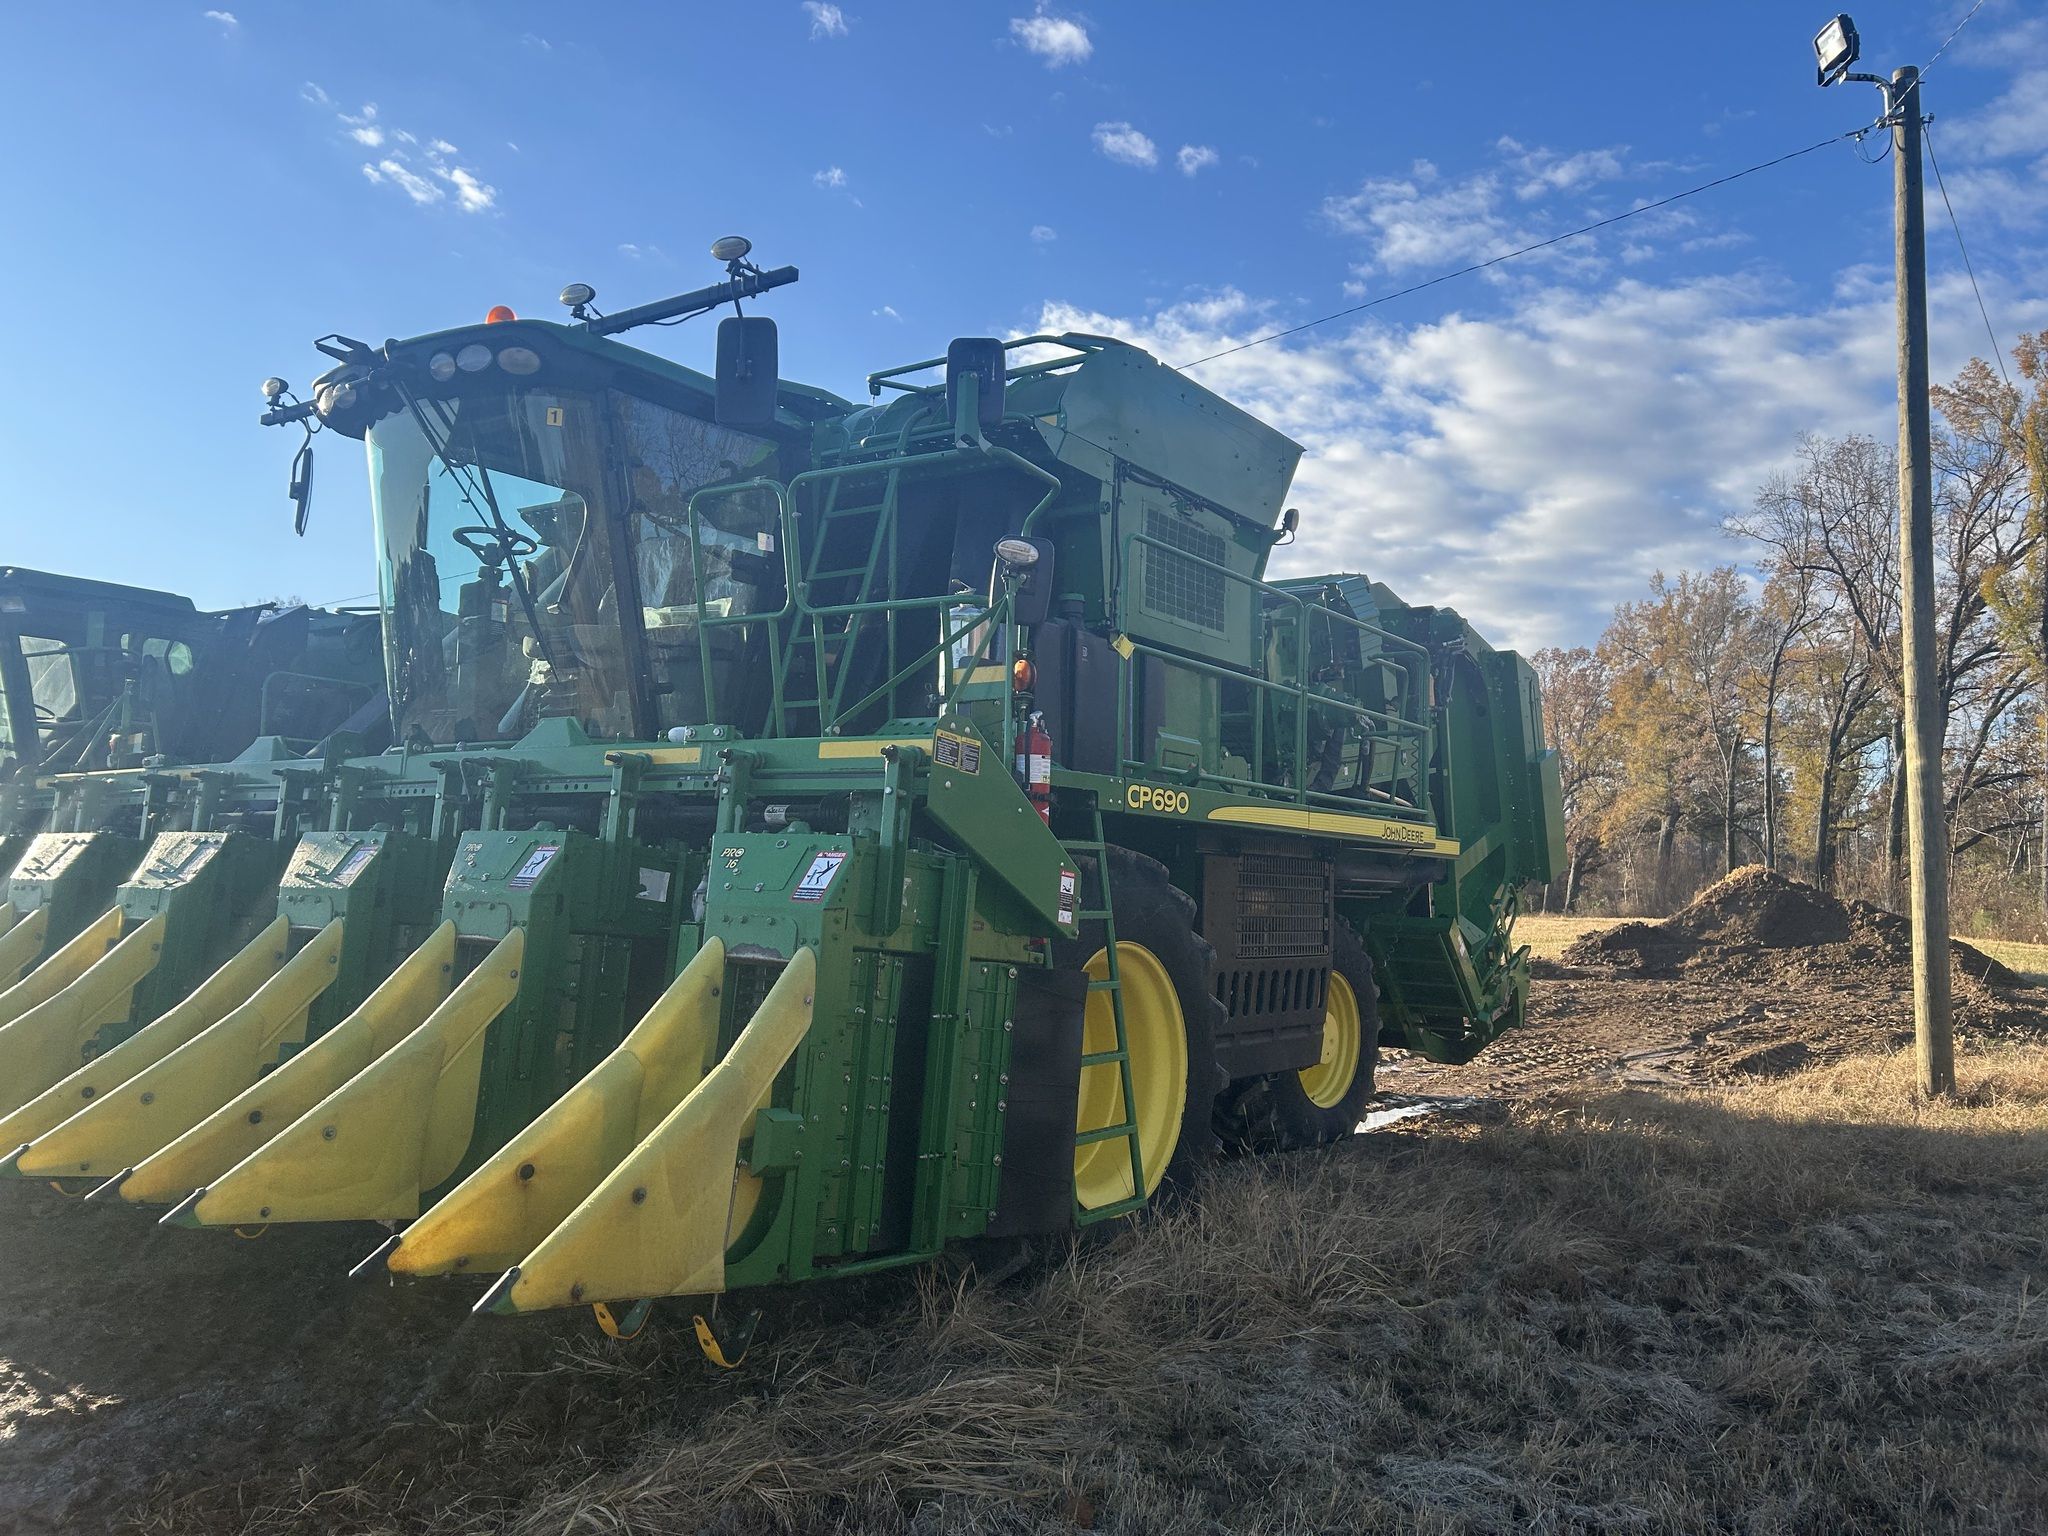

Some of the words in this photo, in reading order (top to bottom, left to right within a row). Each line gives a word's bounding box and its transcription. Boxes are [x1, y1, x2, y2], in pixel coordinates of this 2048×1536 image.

[551, 410, 557, 423] 1
[1127, 784, 1190, 815] CP690
[1382, 824, 1401, 840] JOHN
[1402, 826, 1424, 843] DEERE
[720, 848, 745, 858] PRO
[725, 859, 739, 869] 16
